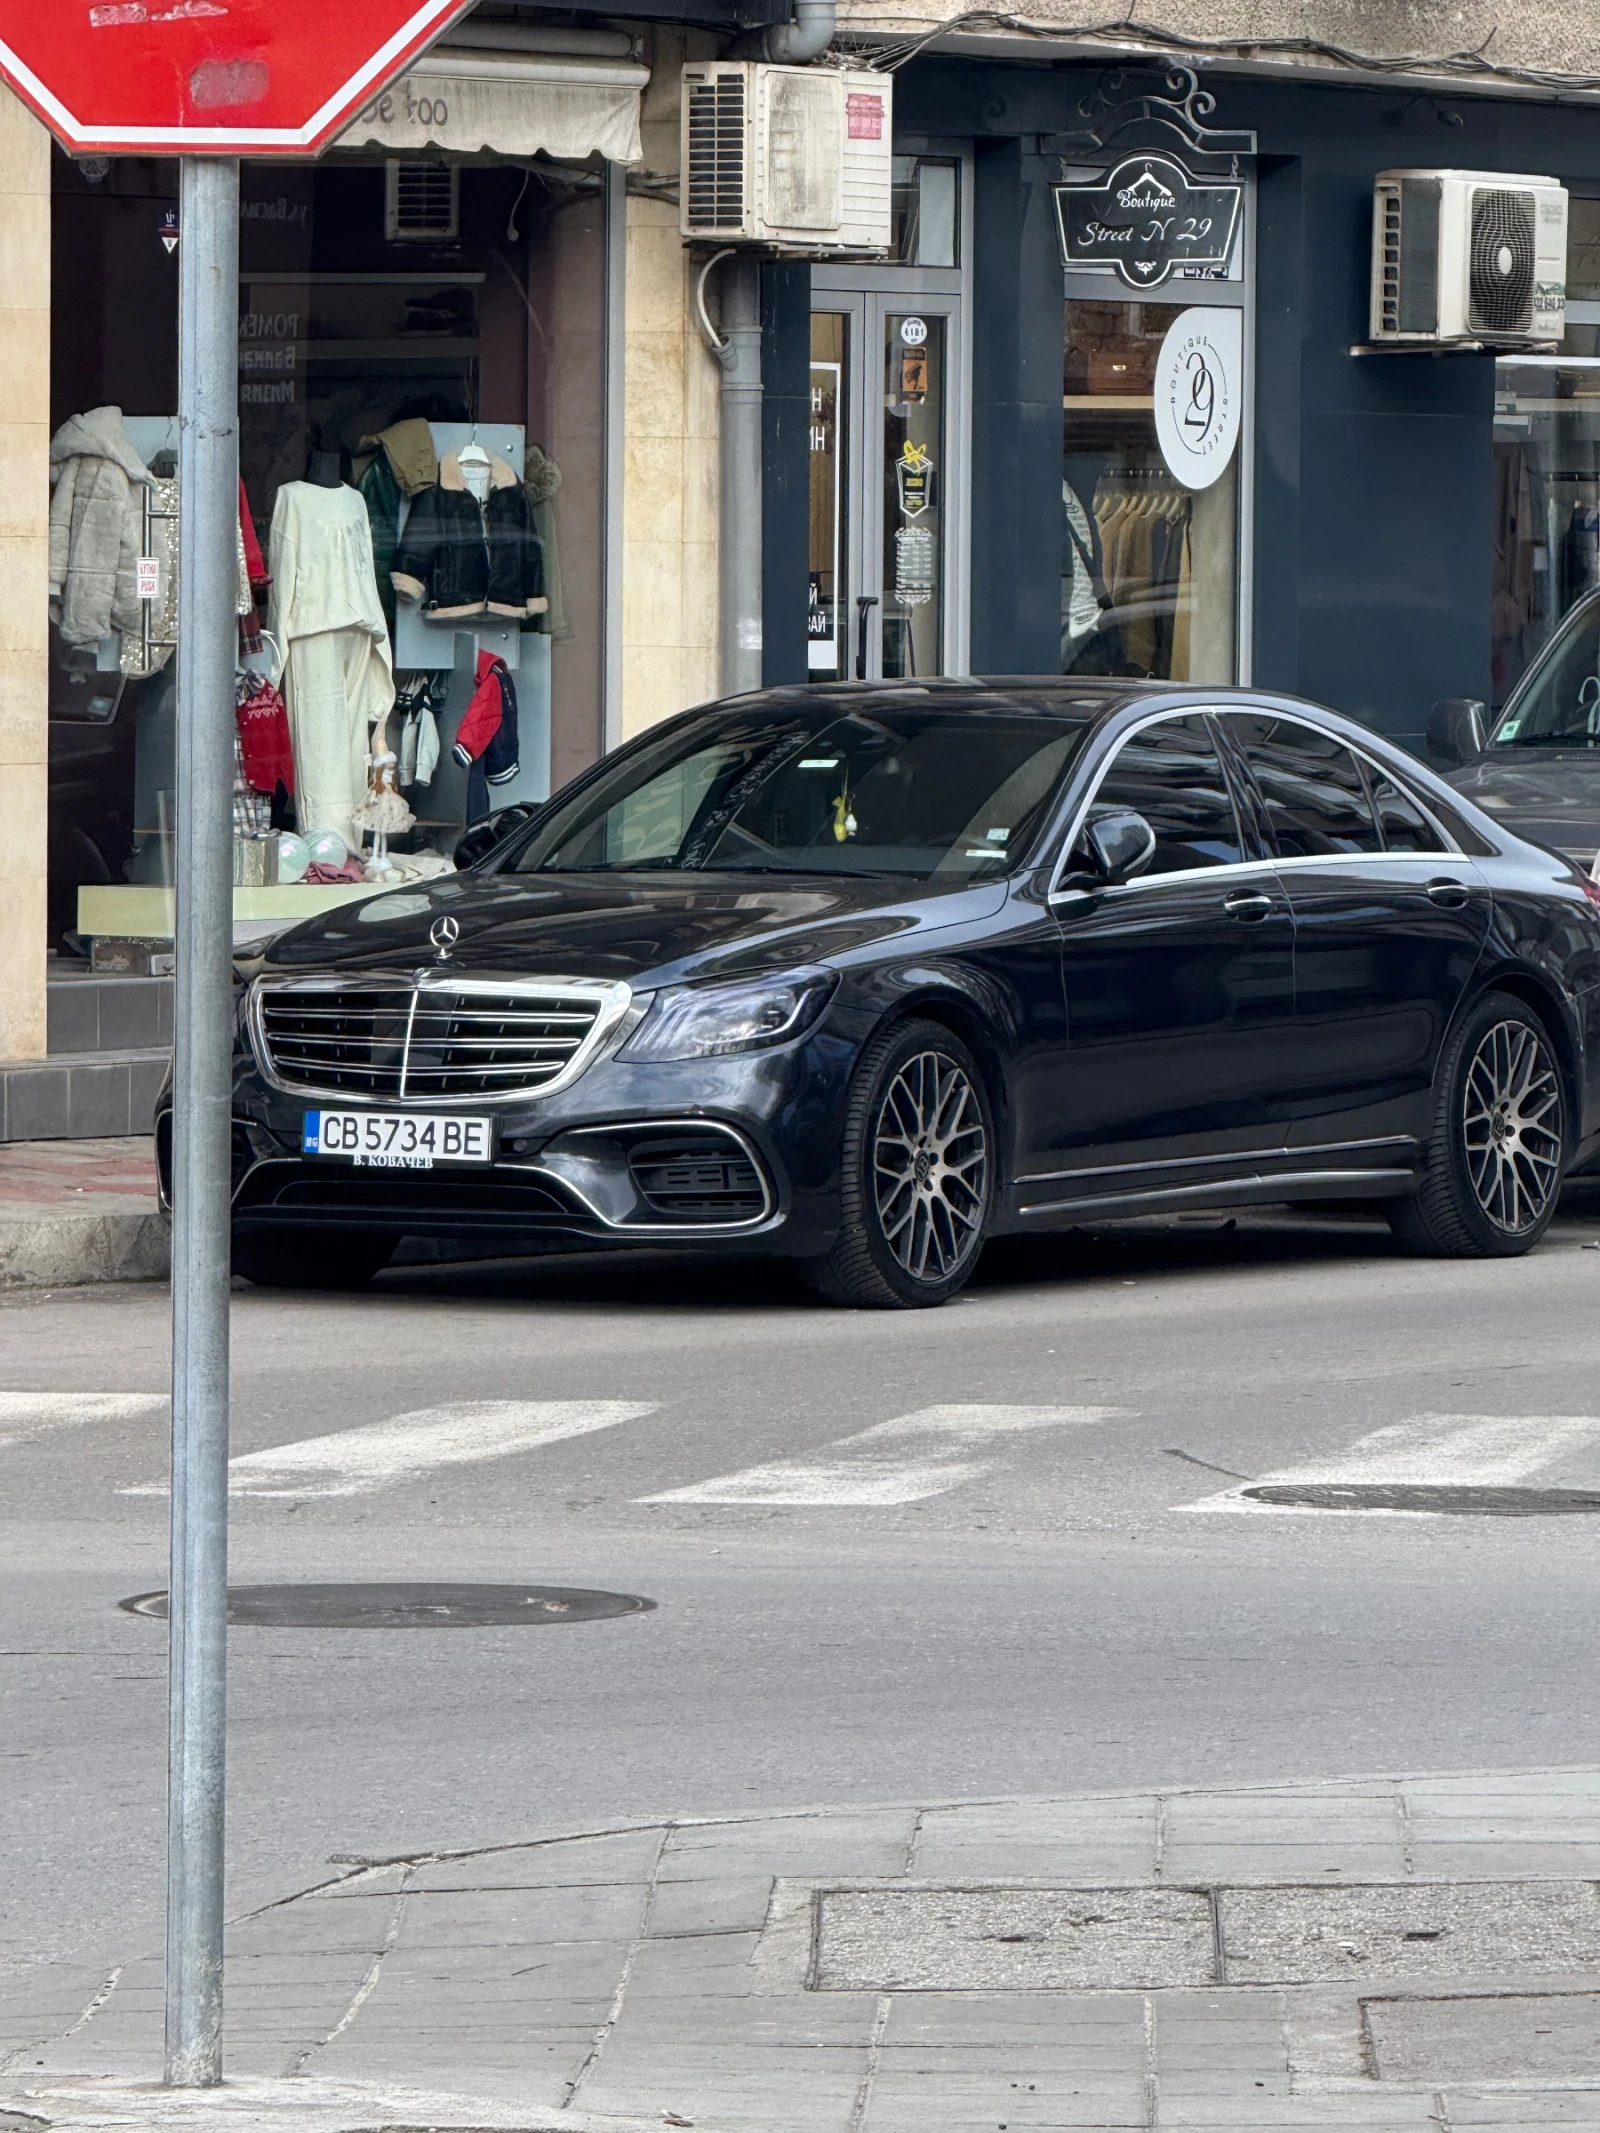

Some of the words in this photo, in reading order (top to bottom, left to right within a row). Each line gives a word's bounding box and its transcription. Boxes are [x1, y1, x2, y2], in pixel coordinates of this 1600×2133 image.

[1117, 190, 1176, 213] Boutique
[1077, 221, 1135, 246] Street
[1141, 217, 1176, 241] N
[1176, 217, 1213, 241] 29
[305, 1136, 319, 1148] BG
[365, 1118, 436, 1153] 5734
[368, 1155, 434, 1169] КОВАЧЕВ
